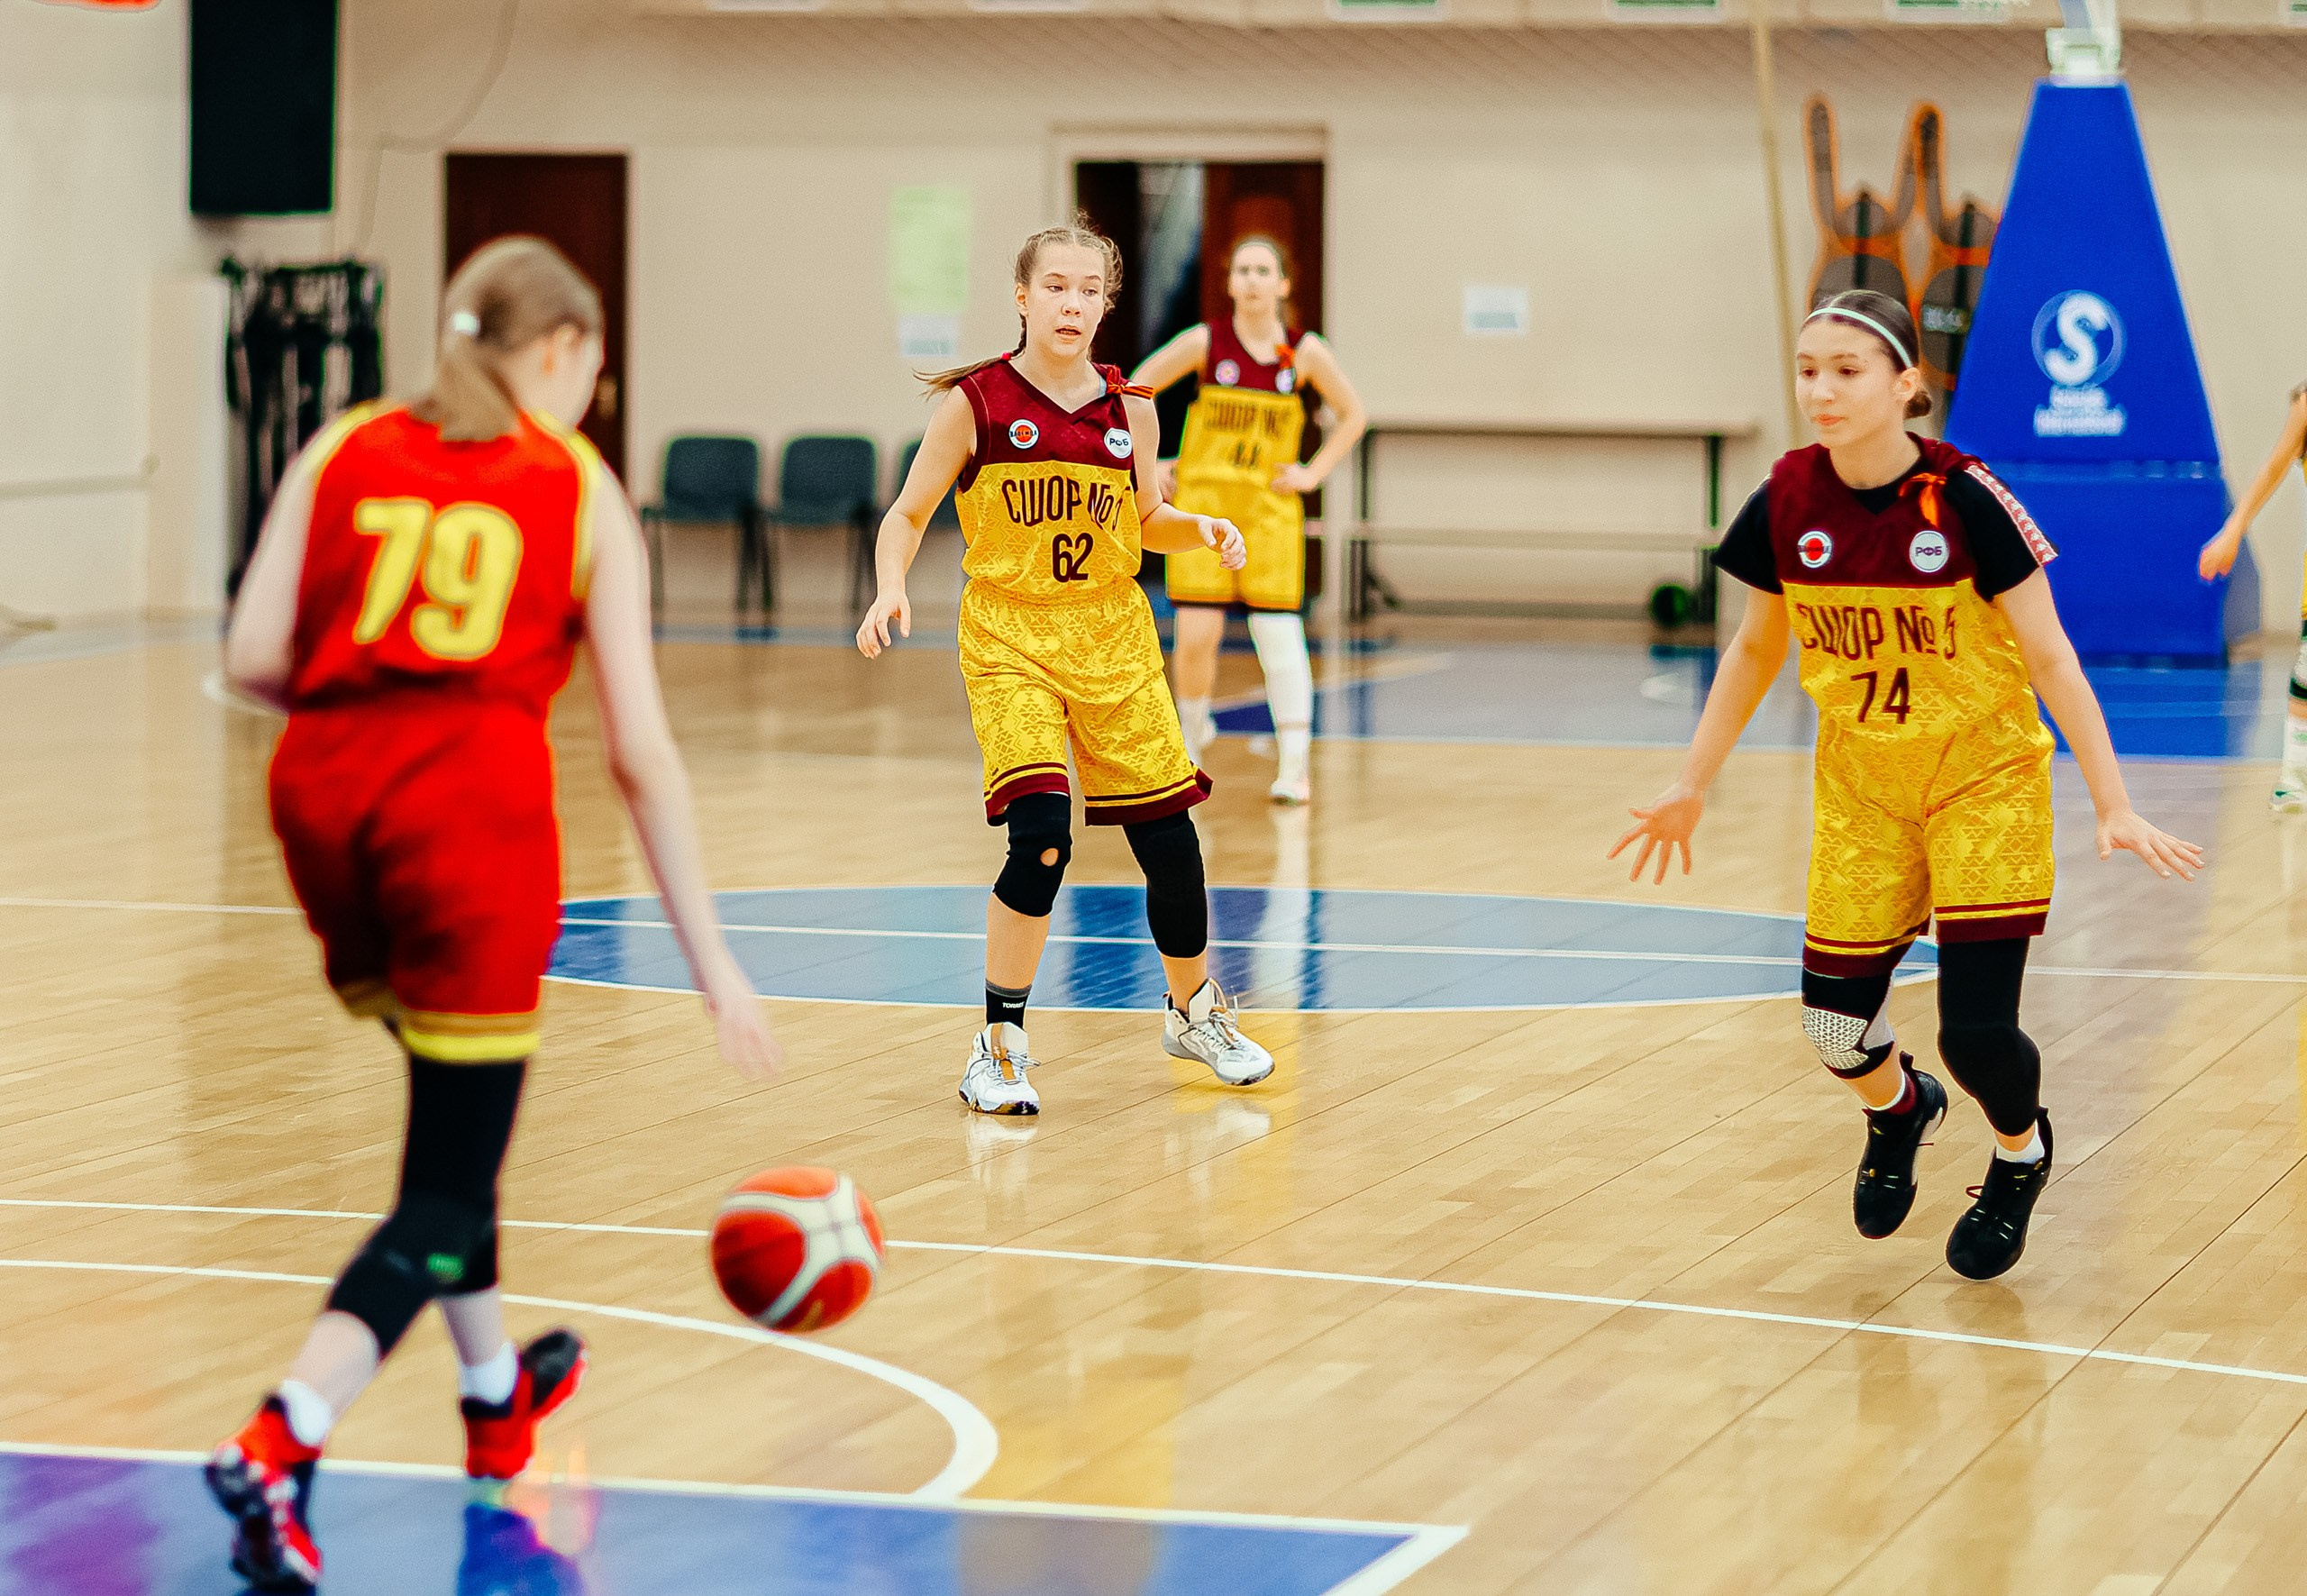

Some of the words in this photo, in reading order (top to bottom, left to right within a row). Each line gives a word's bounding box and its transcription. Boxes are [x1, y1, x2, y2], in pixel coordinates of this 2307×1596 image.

[1001, 475, 1082, 527] СШОР
[352, 495, 524, 662] 79
[1053, 533, 1094, 583] 62
[1915, 545, 1943, 557] РФБ
[1795, 603, 1884, 661] СШОР
[1850, 667, 1911, 725] 74
